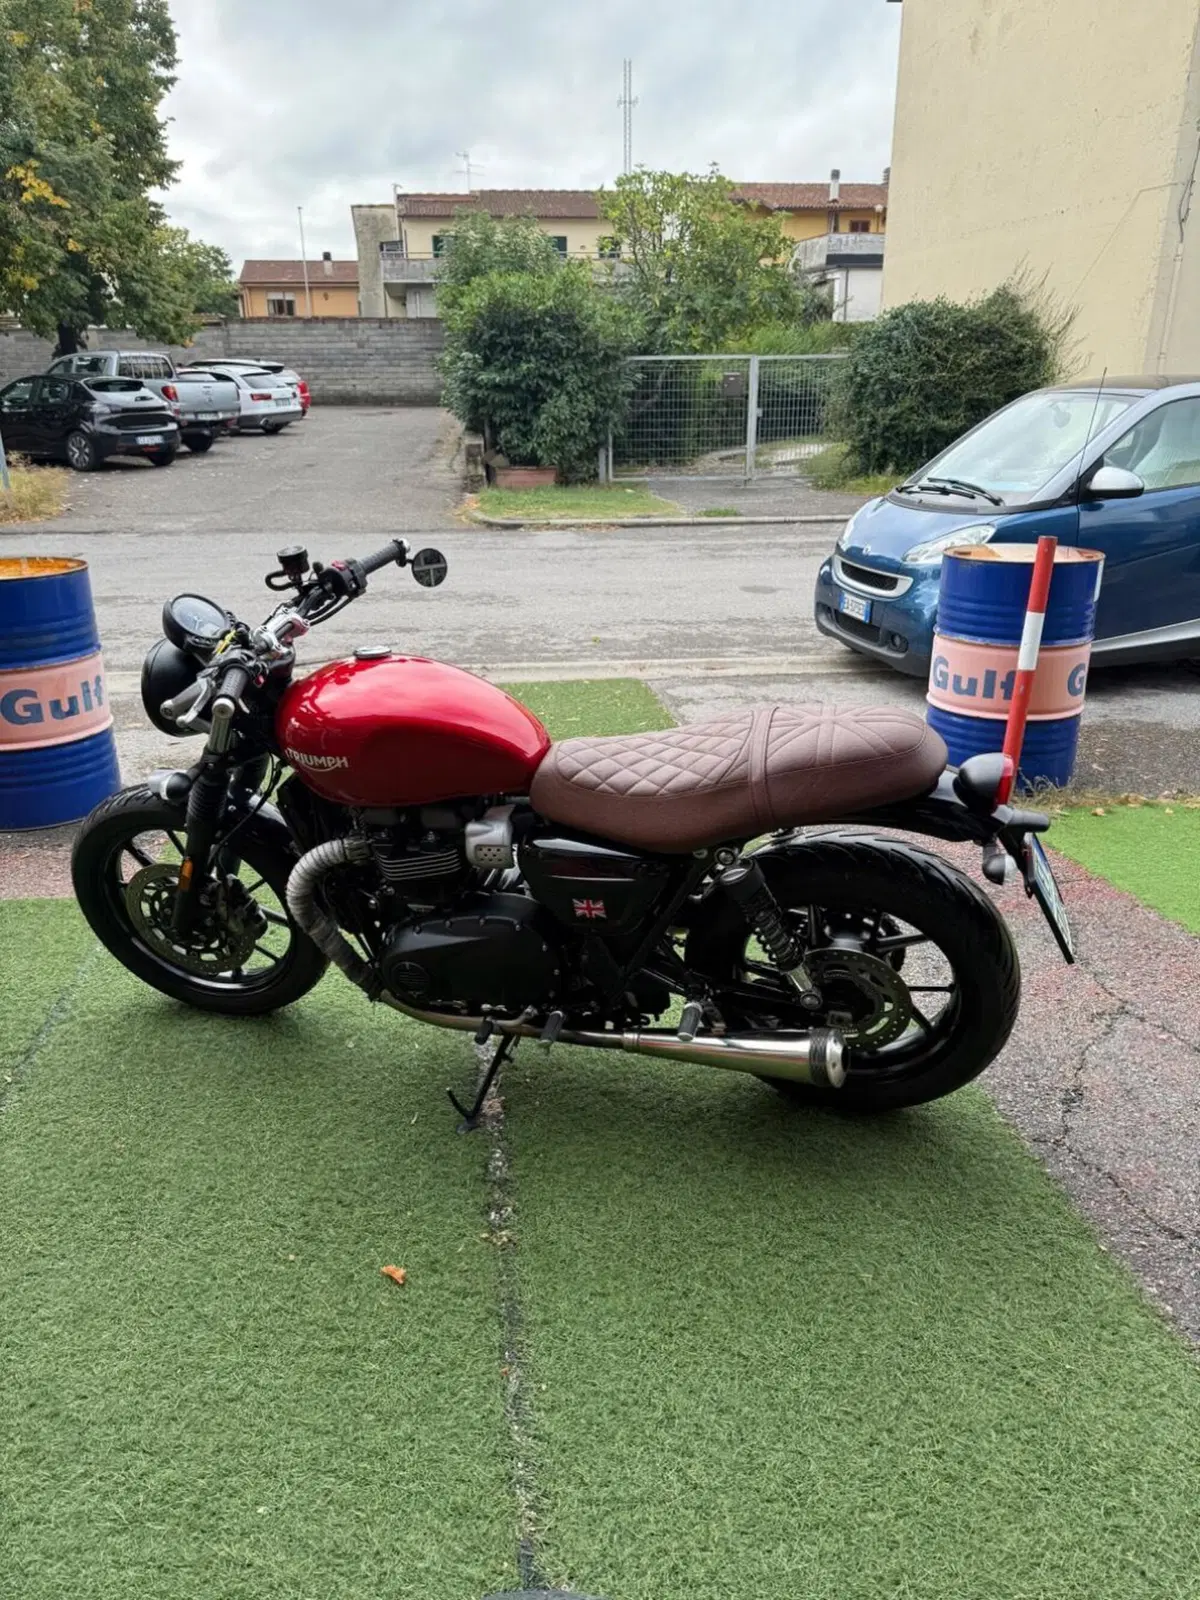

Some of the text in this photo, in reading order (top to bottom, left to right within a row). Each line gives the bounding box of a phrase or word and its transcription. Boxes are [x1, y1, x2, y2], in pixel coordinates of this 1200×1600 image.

[0, 675, 103, 725] Gulf
[932, 655, 1018, 701] Gulf
[285, 747, 349, 770] TRIUMPH
